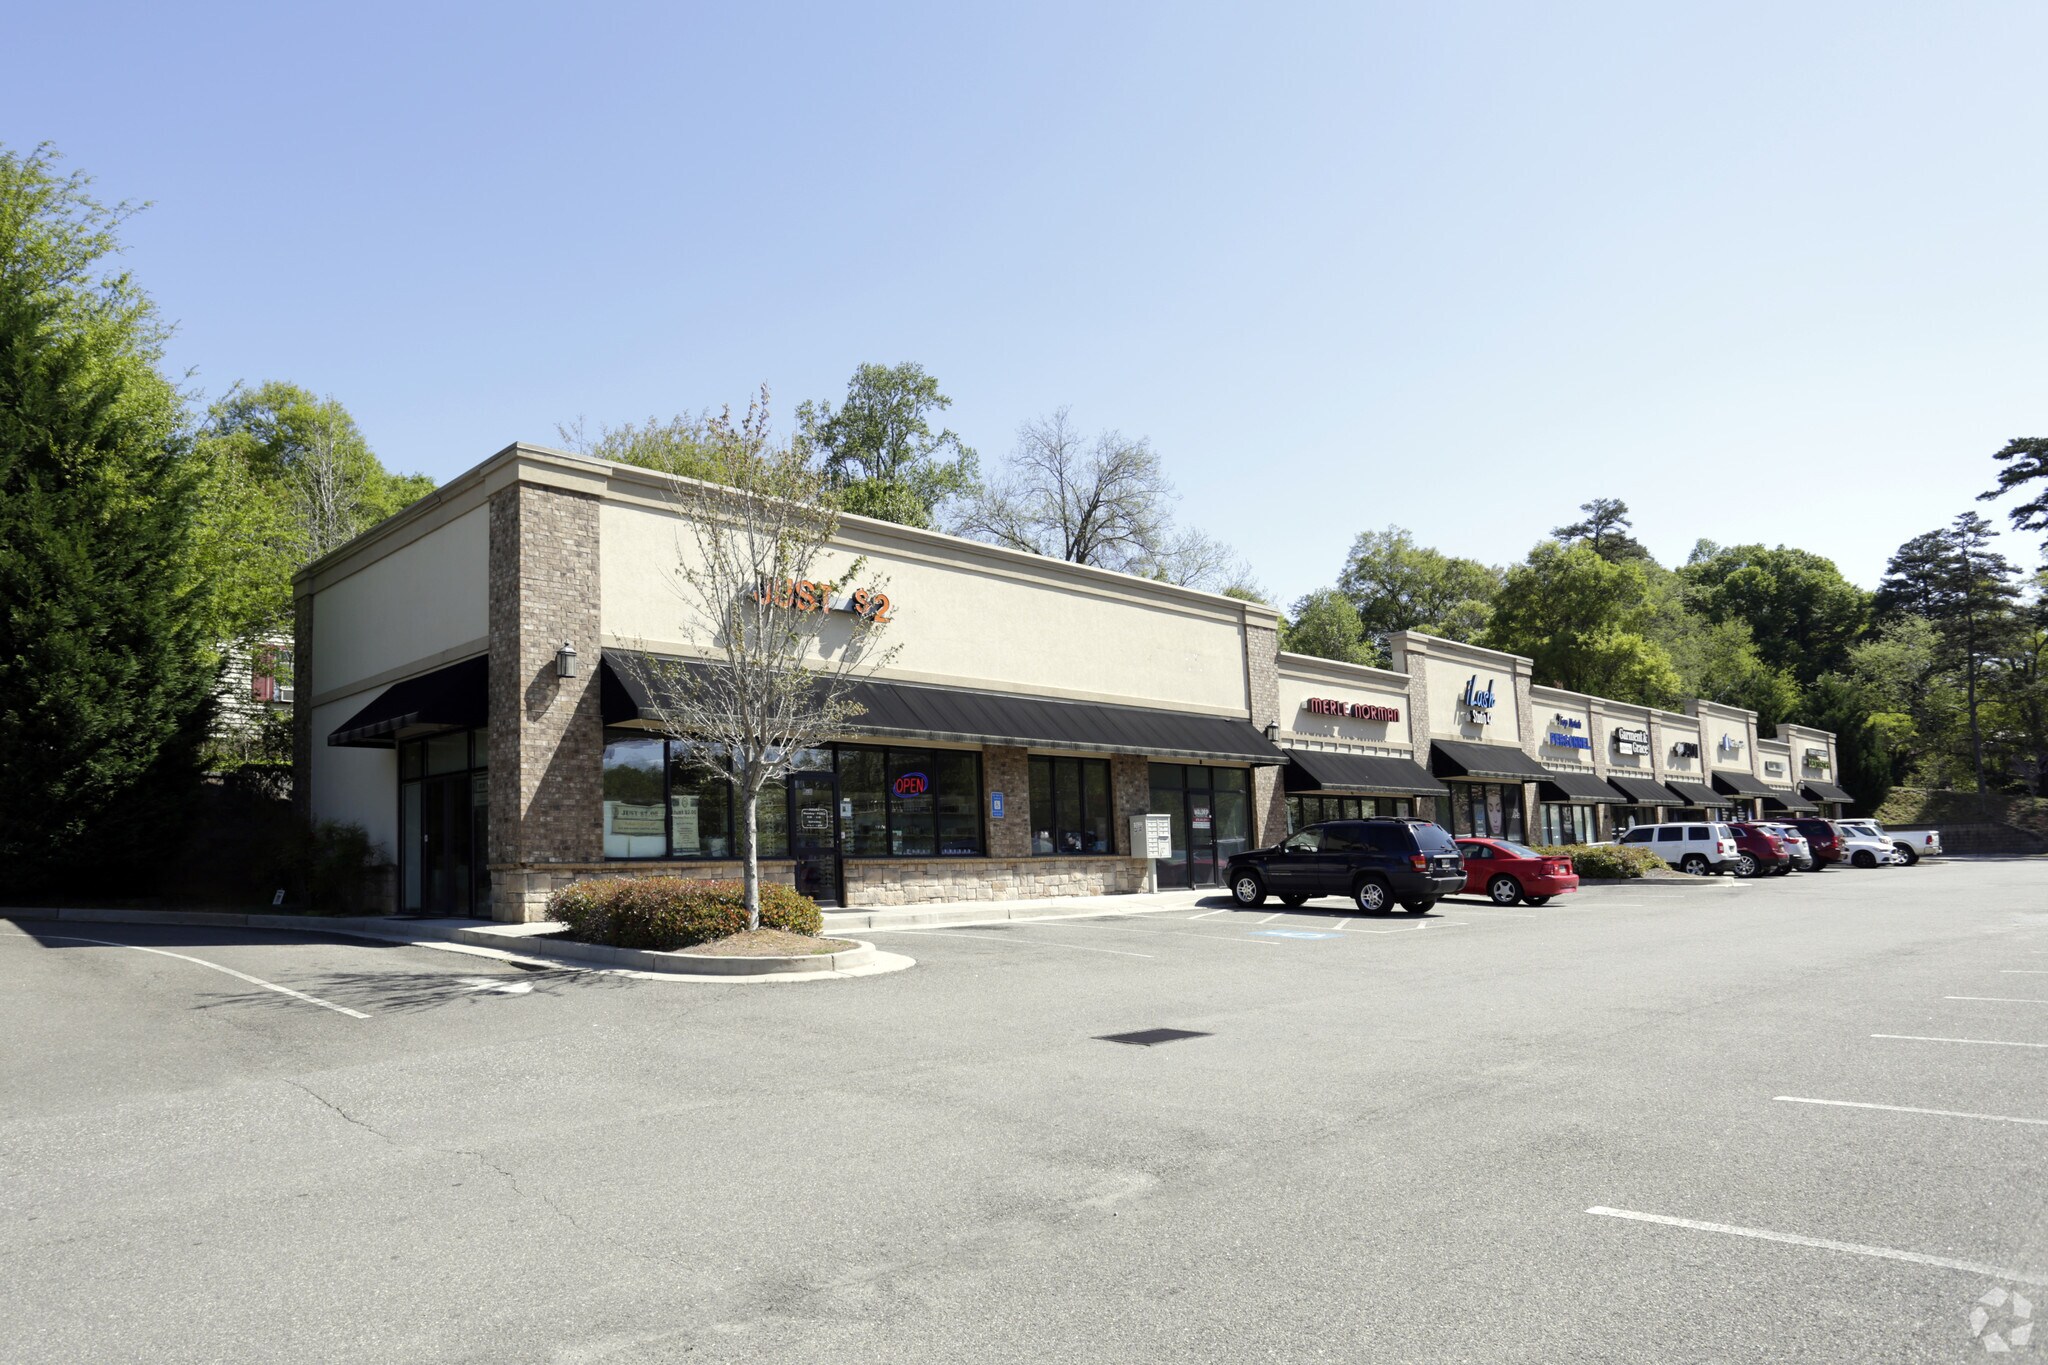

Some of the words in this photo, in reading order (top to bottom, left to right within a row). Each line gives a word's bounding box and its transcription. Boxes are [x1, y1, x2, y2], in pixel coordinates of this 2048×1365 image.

[754, 577, 833, 614] JUST
[1310, 697, 1349, 717] MERLE
[1354, 702, 1400, 722] NORMAN
[895, 778, 924, 794] OPEN
